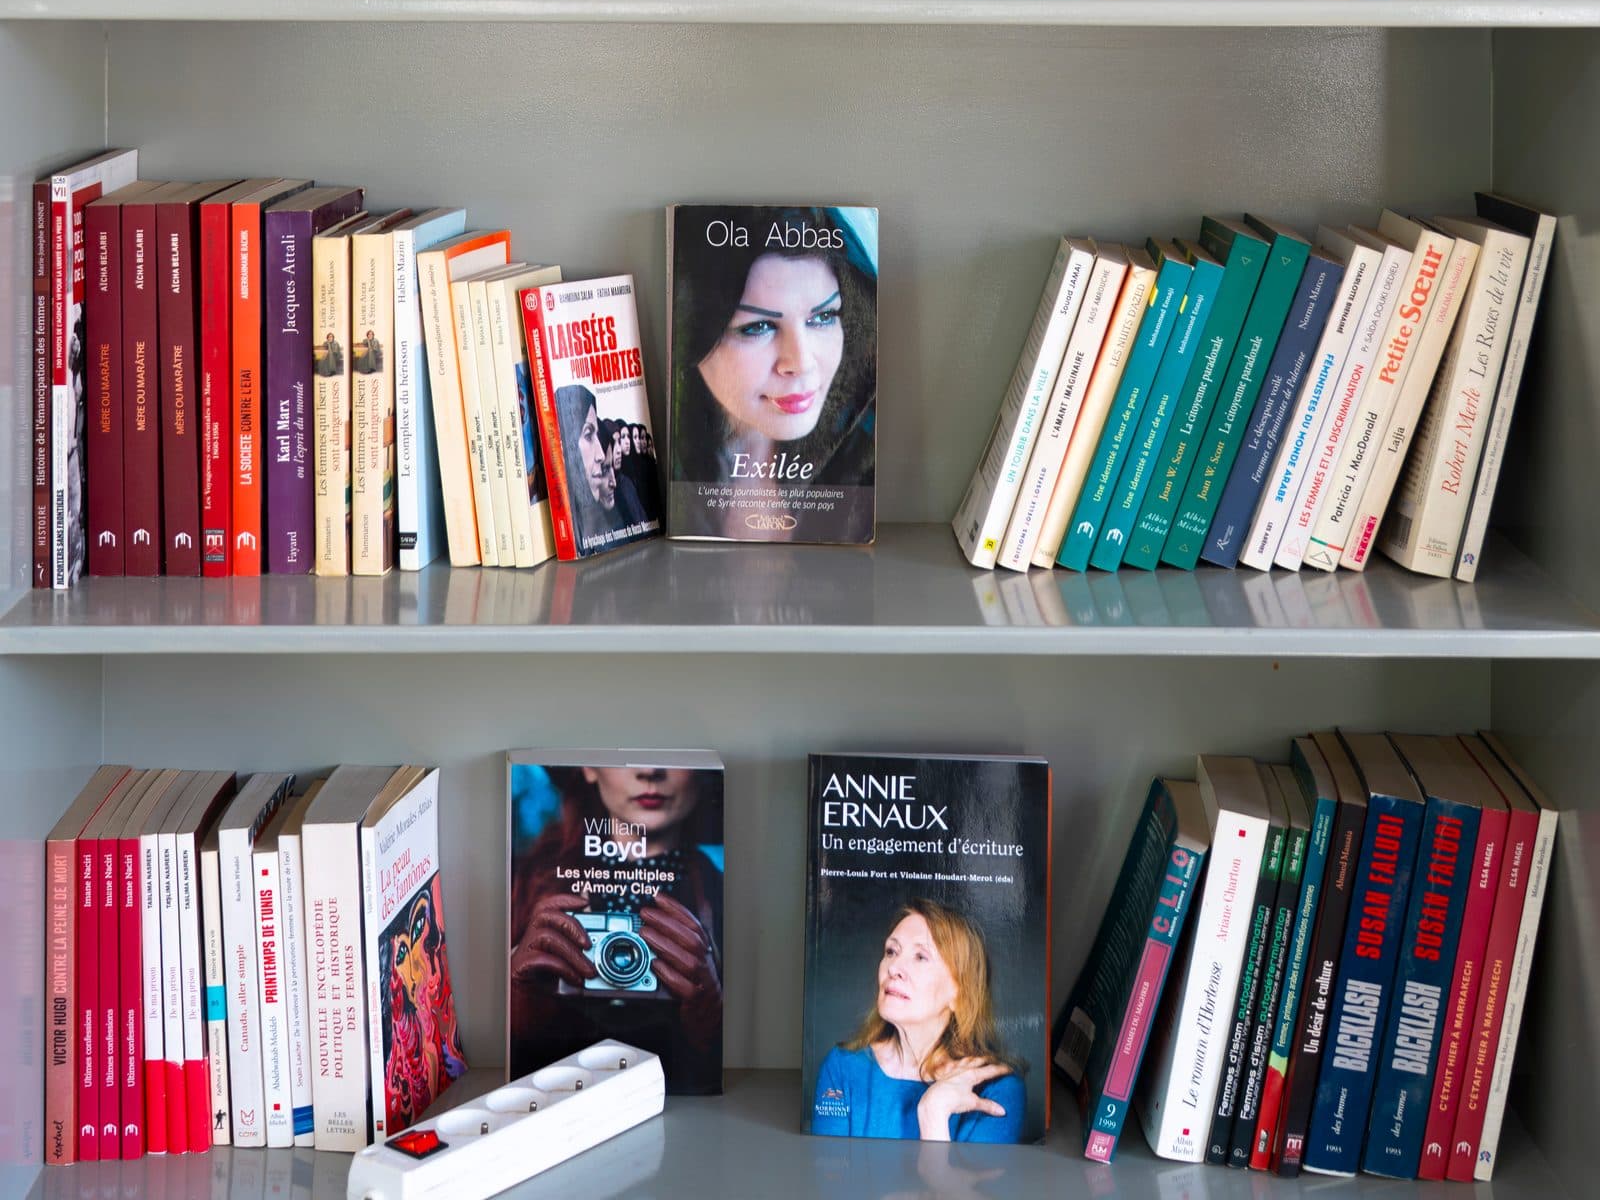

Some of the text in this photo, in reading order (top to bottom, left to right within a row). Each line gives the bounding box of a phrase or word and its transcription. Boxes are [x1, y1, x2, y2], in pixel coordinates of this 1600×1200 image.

[706, 220, 843, 248] Ola Abbas
[281, 234, 300, 335] Jacques Attali
[1378, 244, 1444, 384] Petite Sœur
[1469, 248, 1514, 379] Les Roses de la vie
[547, 312, 618, 360] LAISSÉES
[570, 347, 642, 385] POUR MORTES
[276, 400, 290, 463] Karl Marx
[1275, 353, 1335, 503] FÉMINISTES DU MONDE ARABE
[1388, 426, 1406, 454] Lajja
[1441, 387, 1481, 496] Robert Merle
[698, 486, 844, 501] L'une des journalistes les plus populaires
[730, 452, 813, 480] Exilée
[1158, 441, 1187, 502] Joan W. Scott
[1331, 412, 1378, 523] Patricia J. MacDonald
[707, 498, 835, 511] de Syrie raconte l'enfer de son pays
[287, 531, 300, 563] Fayard
[822, 772, 917, 801] ANNIE
[823, 801, 949, 831] ERNAUX
[584, 817, 647, 836] William
[584, 835, 647, 862] Boyd
[822, 833, 1024, 857] Un engagement d'écriture
[556, 866, 675, 882] Les vies multiples
[571, 880, 660, 897] d'Amory Clay
[1355, 813, 1405, 960] SUSAN FALUDI
[1413, 815, 1463, 961] SUSAN FALUDI
[53, 855, 67, 1066] VICTOR HUGO CONTRE LA PEINE DE MORT
[260, 889, 278, 1004] PRINTEMPS DE TUNIS
[314, 900, 329, 1077] NOUVELLE ENCYCLOPÉDIE
[330, 896, 344, 1079] POLITIQUE ET HISTORIQUE
[345, 945, 356, 1031] DES FEMMES
[1303, 960, 1334, 1054] Un désir de culture
[1182, 961, 1223, 1109] Le roman d'Hortense
[1333, 979, 1382, 1072] BACKLASH
[1392, 980, 1441, 1075] BACKLASH
[1107, 1104, 1116, 1118] 9
